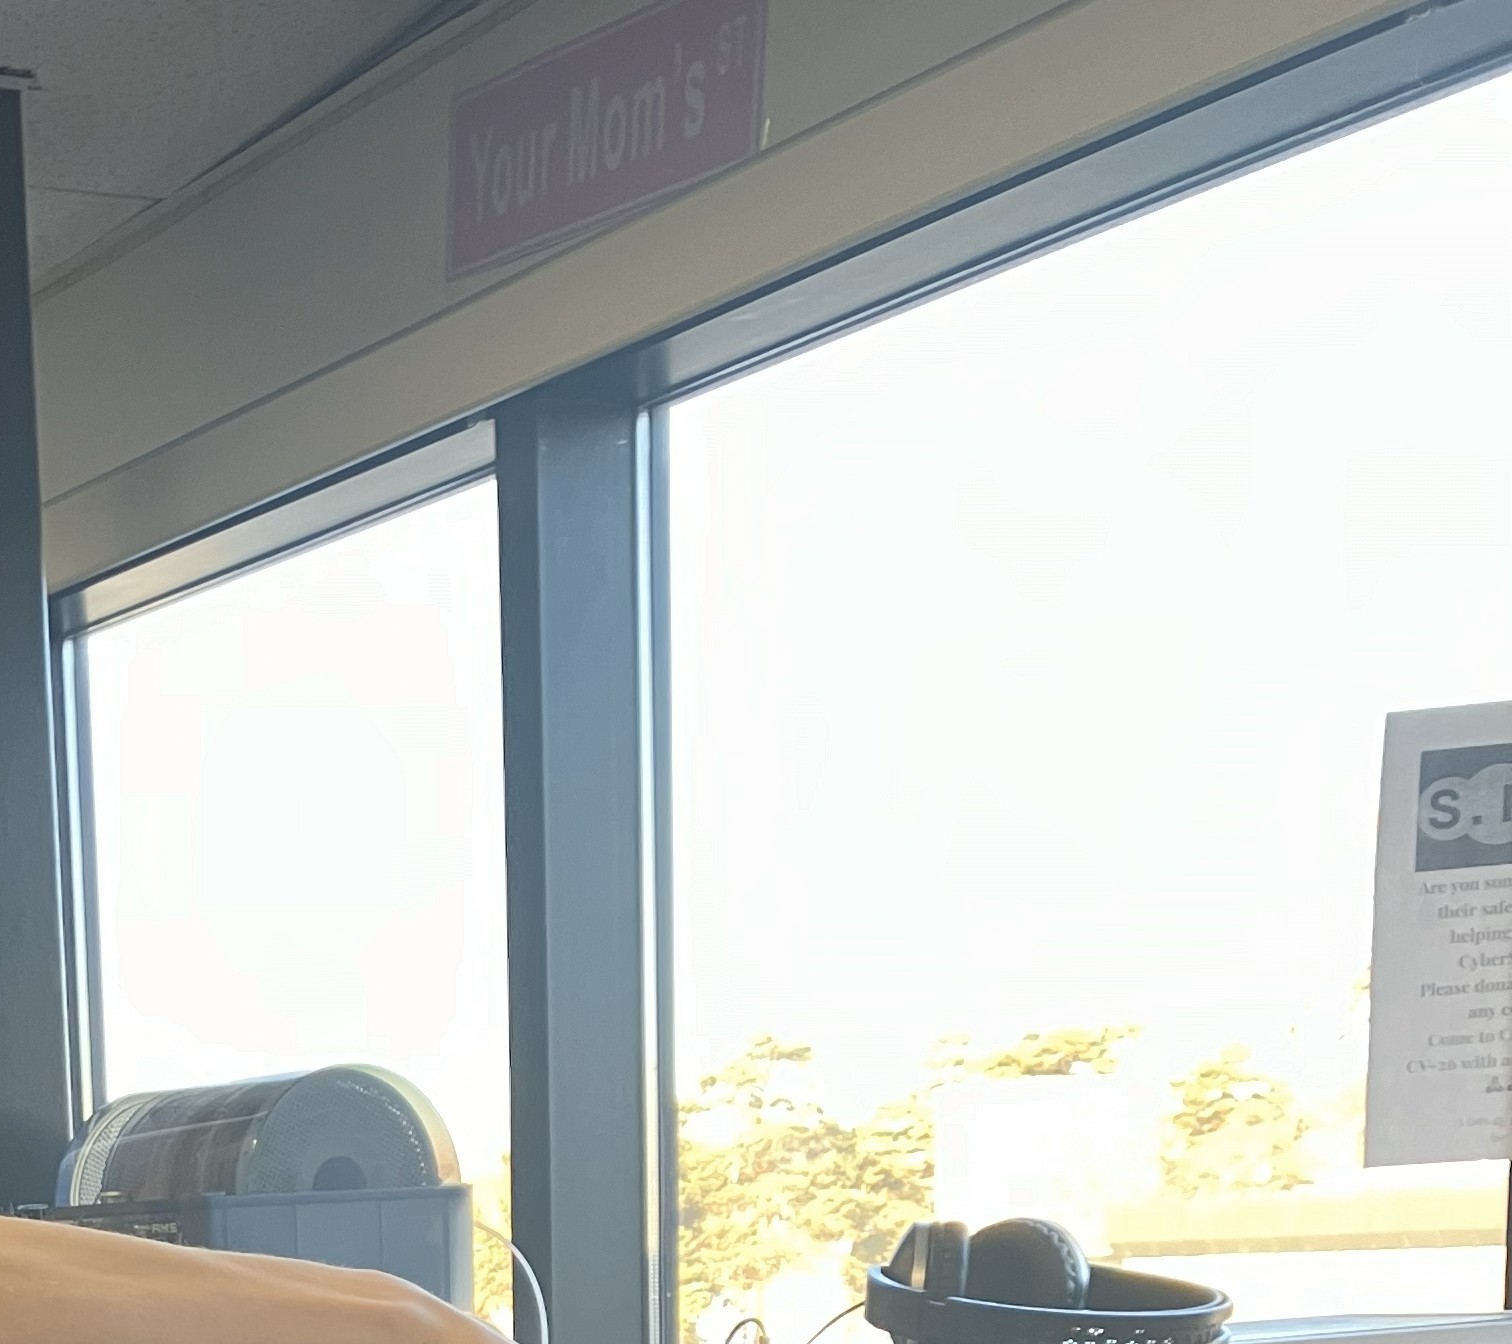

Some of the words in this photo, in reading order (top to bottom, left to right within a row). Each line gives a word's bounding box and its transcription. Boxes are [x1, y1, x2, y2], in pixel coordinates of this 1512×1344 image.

[472, 123, 560, 223] Your
[567, 42, 706, 186] Mom's
[1450, 880, 1480, 895] you
[1437, 903, 1477, 919] their
[1420, 981, 1471, 997] Please
